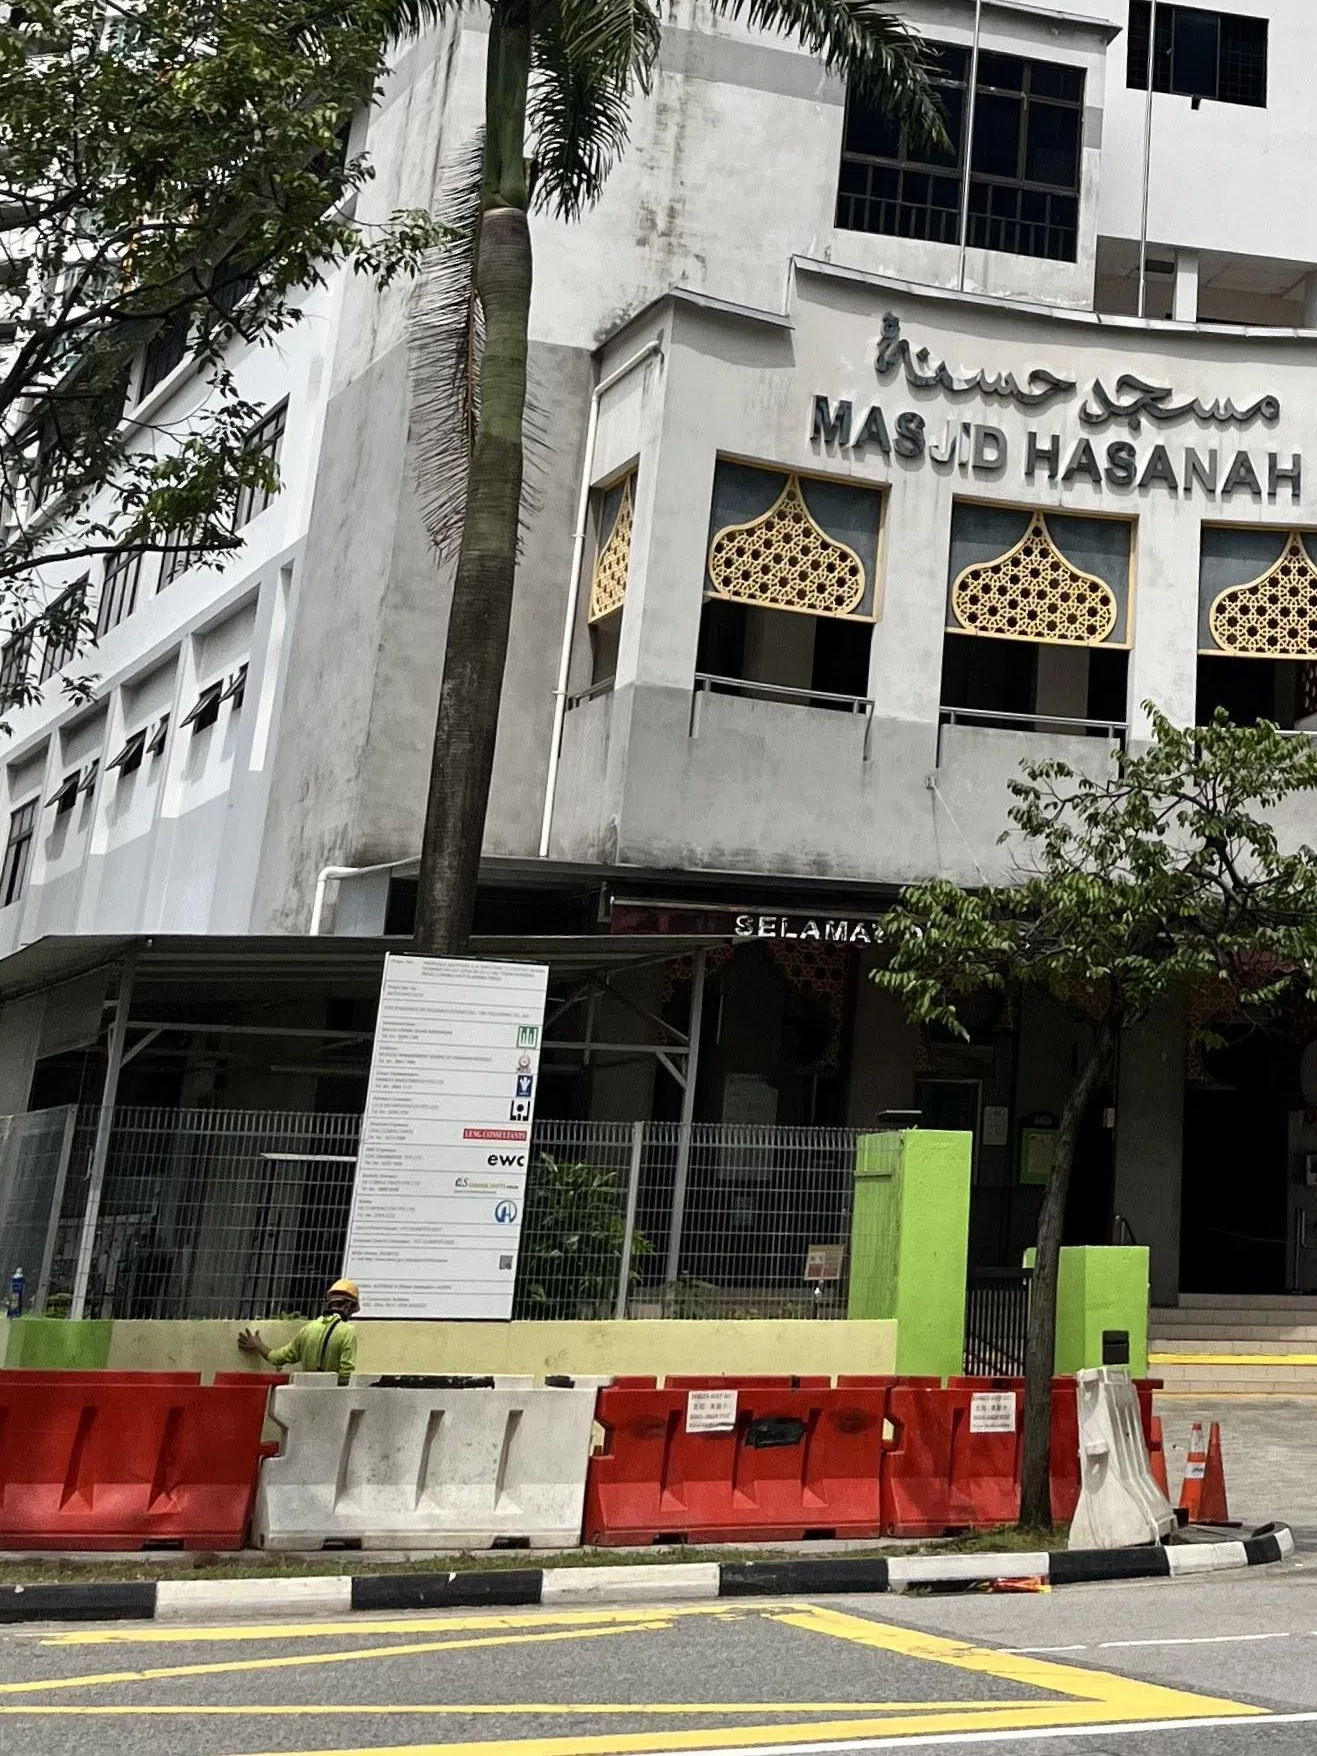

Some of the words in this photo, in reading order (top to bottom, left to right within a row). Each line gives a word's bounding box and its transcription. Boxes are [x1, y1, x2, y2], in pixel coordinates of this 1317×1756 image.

[809, 395, 1008, 471] MASJID
[1024, 431, 1301, 497] HASANAH
[487, 1154, 525, 1167] ewc
